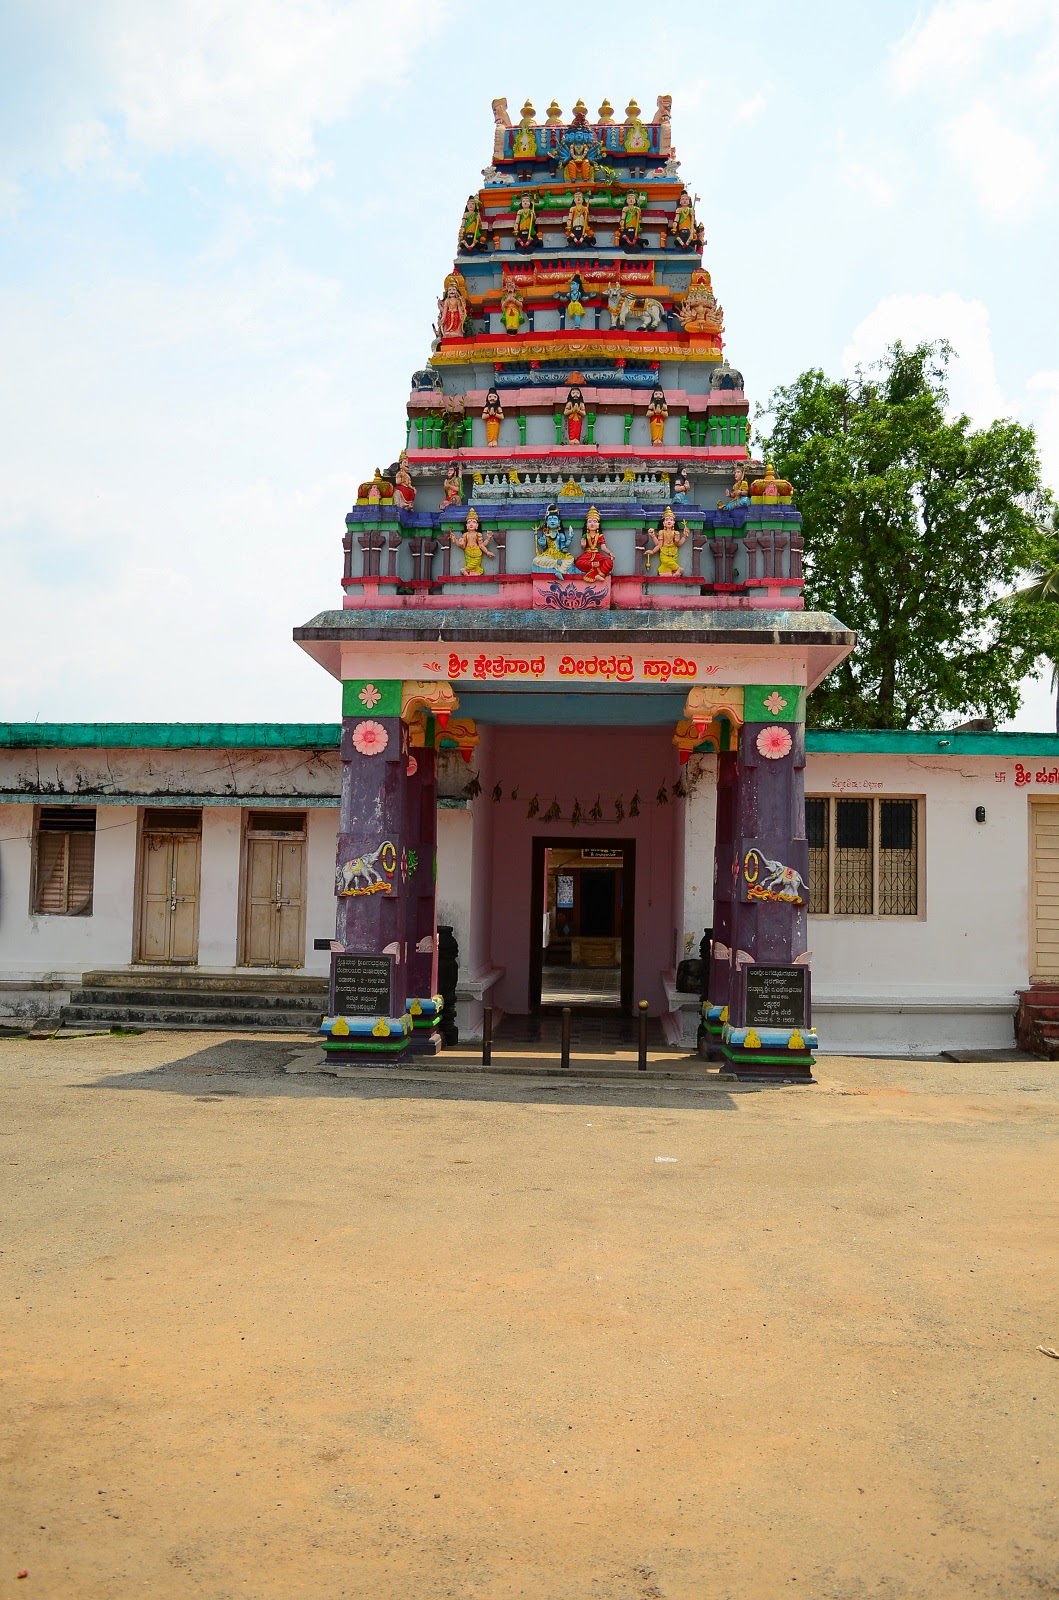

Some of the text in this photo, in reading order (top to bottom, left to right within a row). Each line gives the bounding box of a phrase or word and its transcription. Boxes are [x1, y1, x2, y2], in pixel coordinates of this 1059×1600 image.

[448, 653, 698, 682] ಶ್ರೀ ಕ್ಷೇತ್ರನಾಥ ವೀರಭದ್ರ ಸ್ವಾಮಿ
[1014, 763, 1031, 787] ಶ್ರೀ
